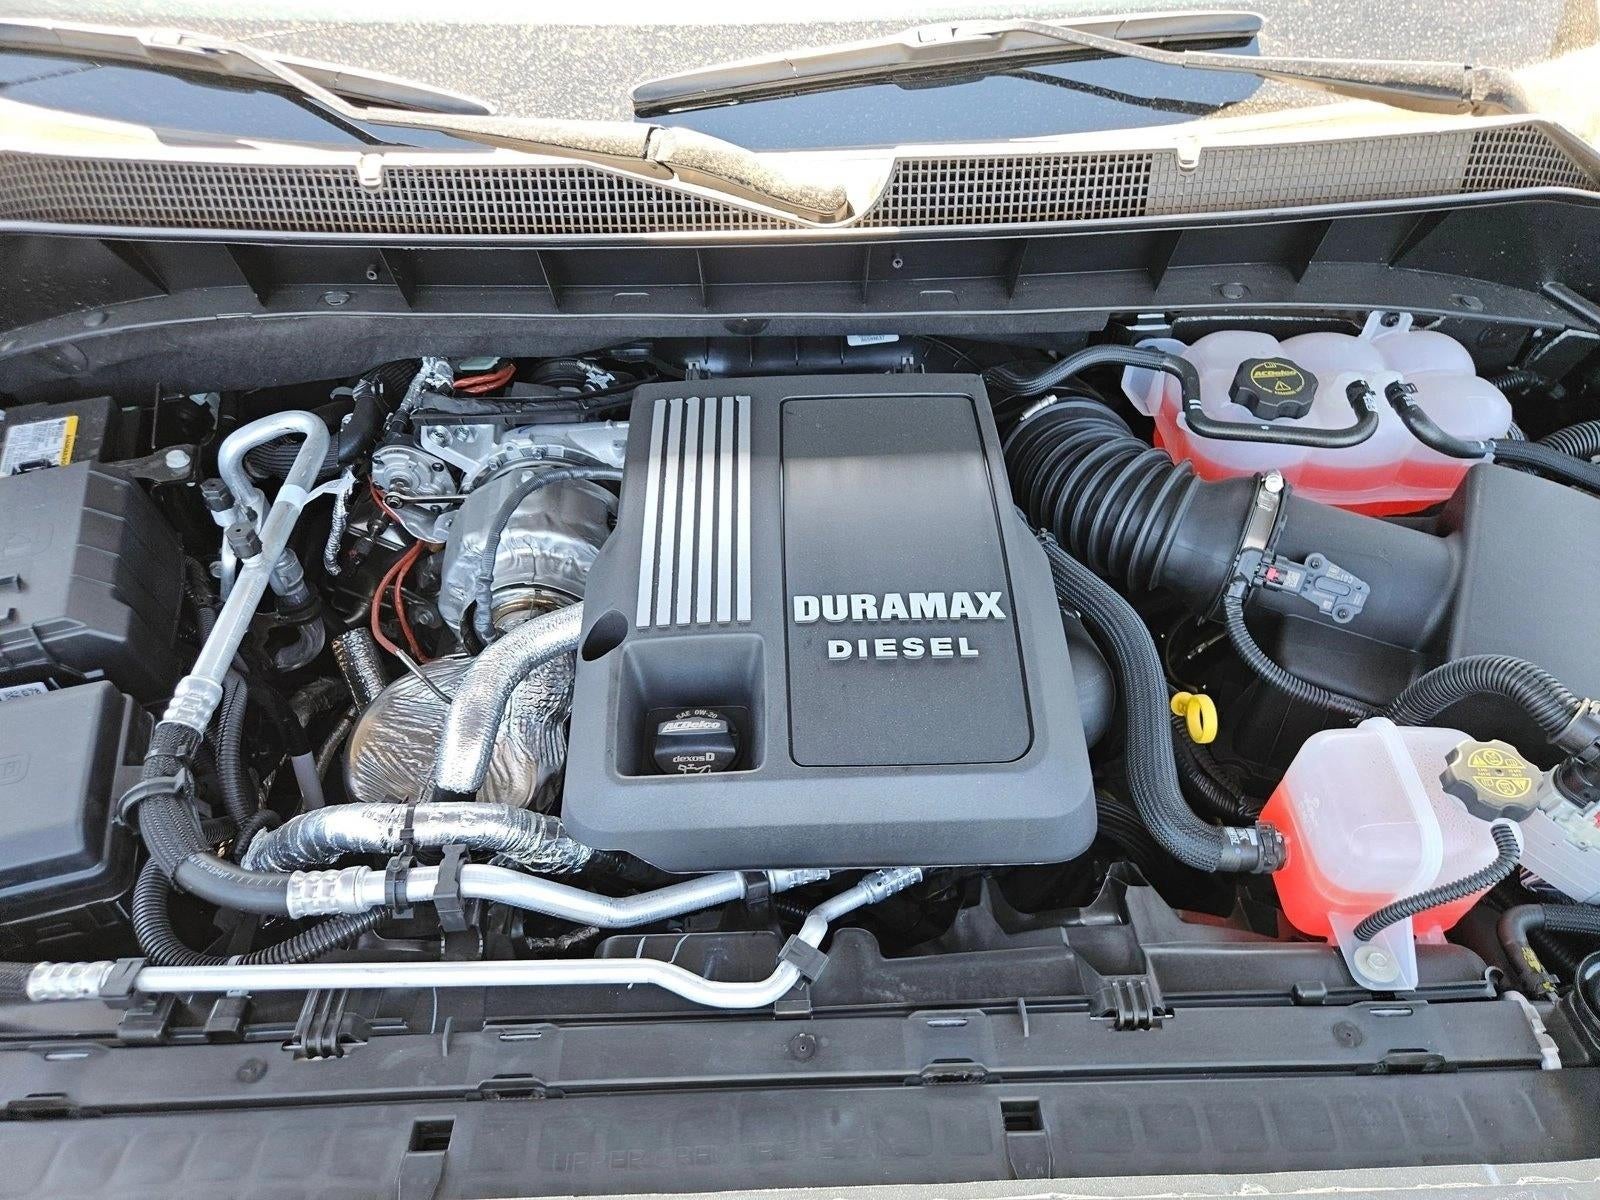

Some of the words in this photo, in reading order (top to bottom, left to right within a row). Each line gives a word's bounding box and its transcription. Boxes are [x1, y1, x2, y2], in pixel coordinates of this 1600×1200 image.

[793, 591, 1006, 624] DURAMAX
[827, 637, 979, 661] DIESEL
[676, 710, 691, 720] SAE
[694, 709, 718, 719] 0W-20
[662, 721, 721, 732] ACDelco
